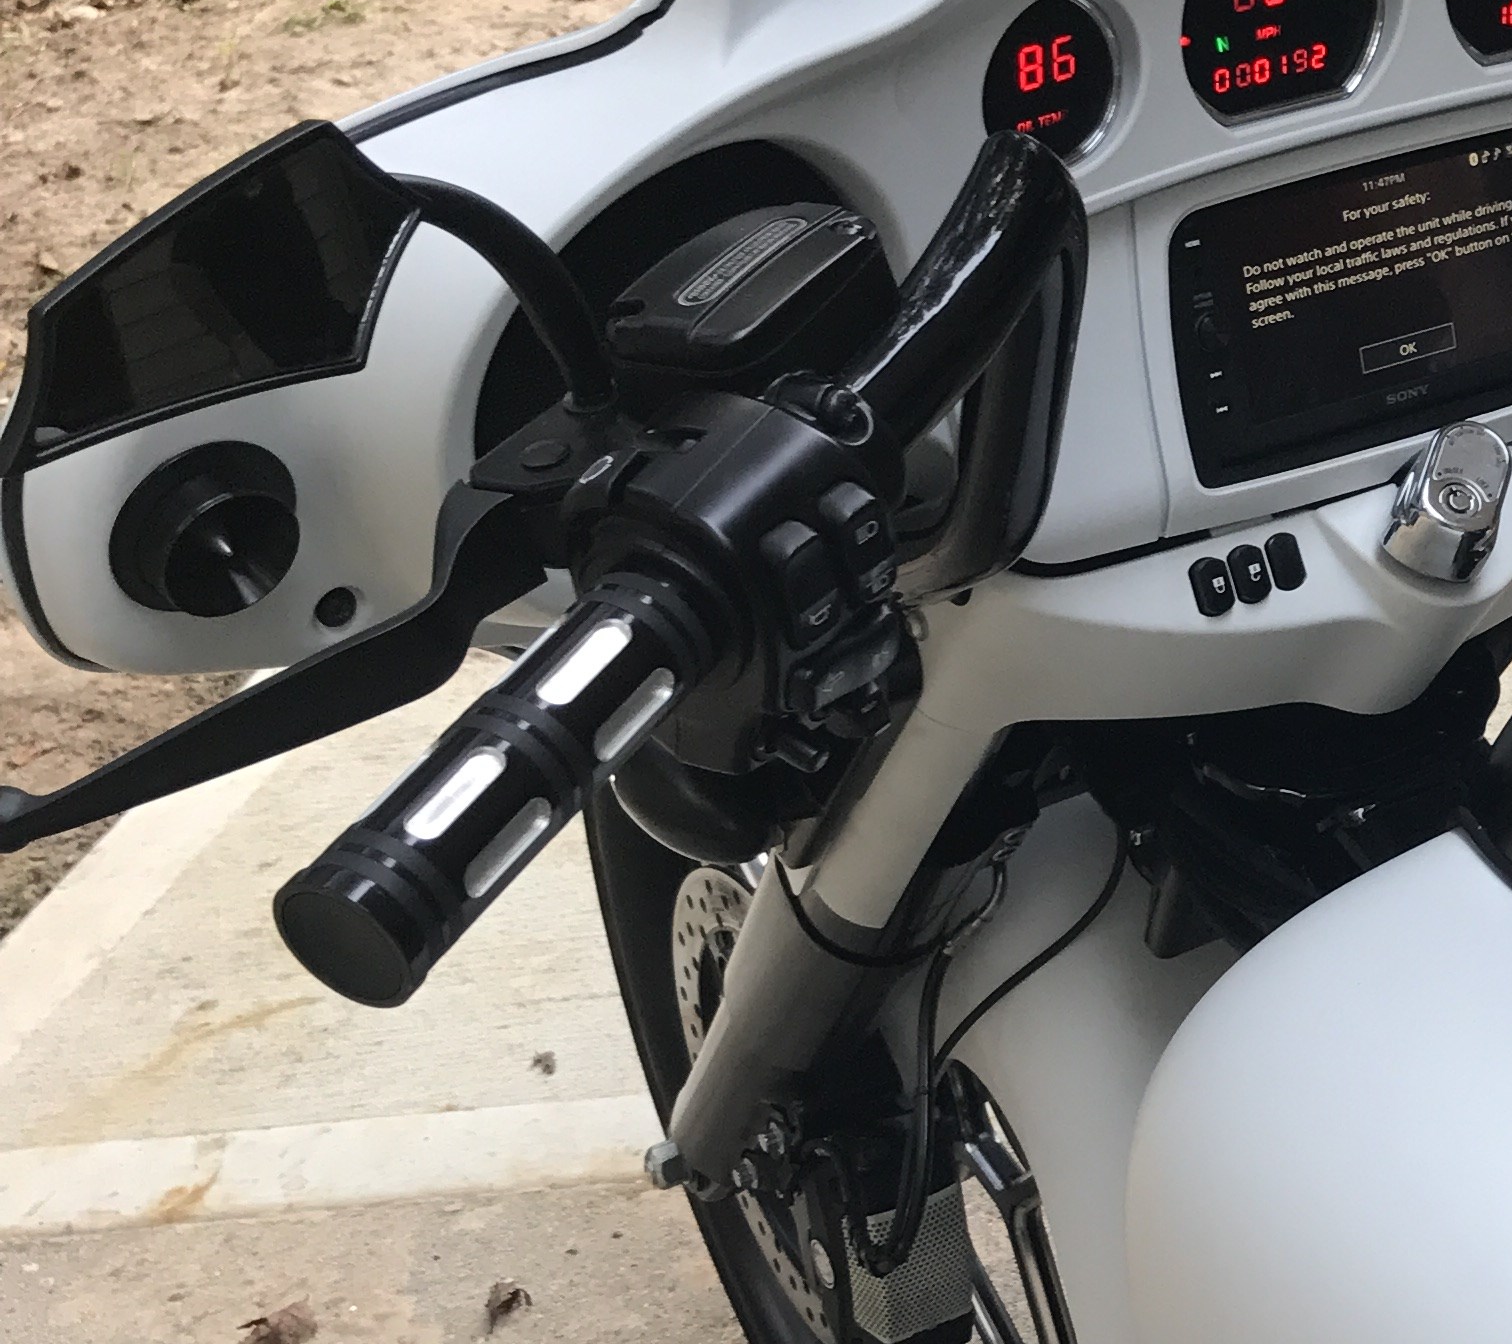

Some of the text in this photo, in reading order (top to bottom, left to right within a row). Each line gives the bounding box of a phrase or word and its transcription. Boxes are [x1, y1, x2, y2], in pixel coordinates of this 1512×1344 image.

[1018, 35, 1076, 92] 86
[1215, 35, 1230, 53] N
[1213, 42, 1327, 93] 000192
[1343, 192, 1431, 222] For your safety:
[1243, 265, 1261, 278] Do
[1264, 258, 1285, 273] not
[1286, 248, 1322, 266] watch
[1325, 241, 1347, 256] and
[1349, 229, 1395, 251] operate
[1396, 224, 1416, 238] the
[1418, 217, 1440, 232] unit
[1442, 209, 1472, 226] while
[1246, 276, 1285, 294] Follow
[1287, 269, 1314, 285] your
[1316, 260, 1344, 276] local
[1346, 250, 1379, 268] traffic
[1381, 244, 1408, 259] laws
[1409, 237, 1432, 252] and
[1433, 220, 1499, 245] regulations.
[1500, 214, 1509, 228] If
[1249, 295, 1283, 312] agree
[1285, 286, 1312, 302] with
[1313, 280, 1336, 294] this
[1395, 257, 1425, 275] press
[1426, 247, 1453, 262] "OK"
[1455, 238, 1493, 256] button
[1494, 235, 1510, 246] on
[1251, 310, 1295, 329] screen.
[1399, 341, 1418, 356] OK
[1386, 384, 1430, 405] SONY
